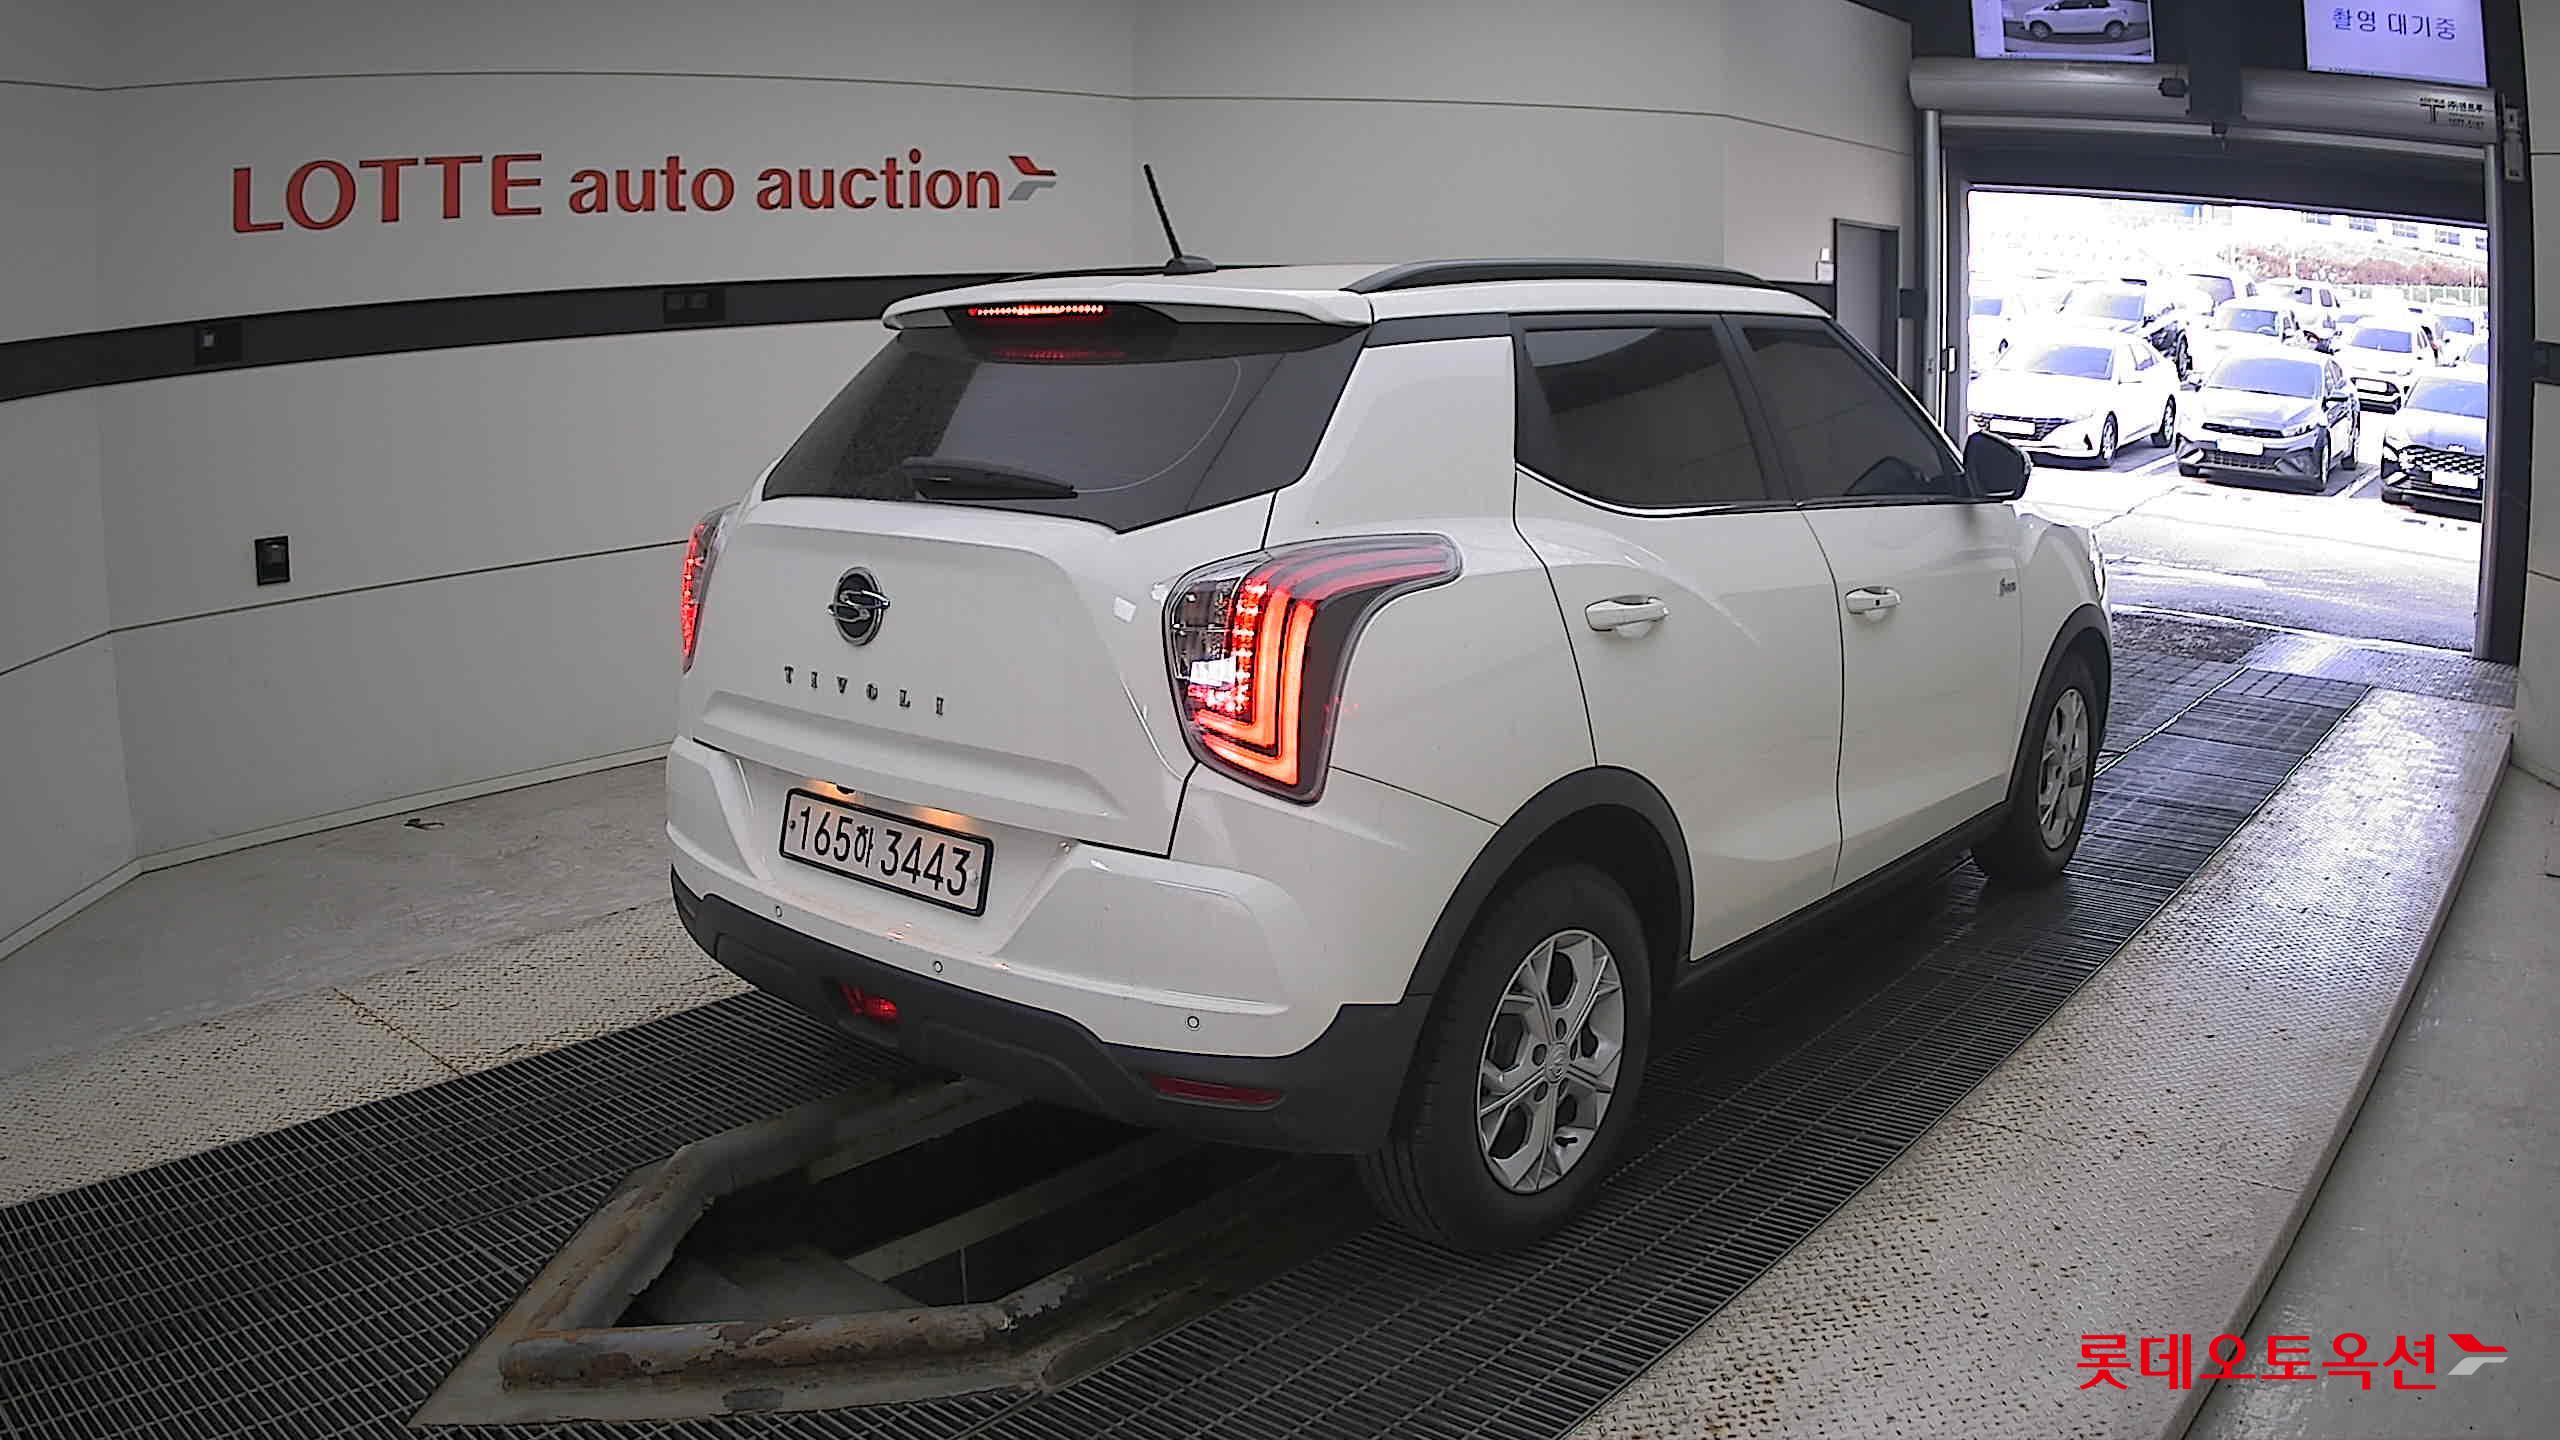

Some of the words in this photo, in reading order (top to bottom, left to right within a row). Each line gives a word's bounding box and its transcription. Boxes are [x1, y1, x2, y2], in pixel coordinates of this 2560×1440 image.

[2331, 7, 2376, 33] 촬영
[2387, 12, 2456, 41] 대기중
[233, 155, 541, 233] LOTTE
[569, 157, 735, 213] auto
[756, 149, 1003, 208] auction
[783, 665, 945, 716] TIVOLI
[799, 805, 874, 869] 165하
[879, 828, 972, 896] 3443
